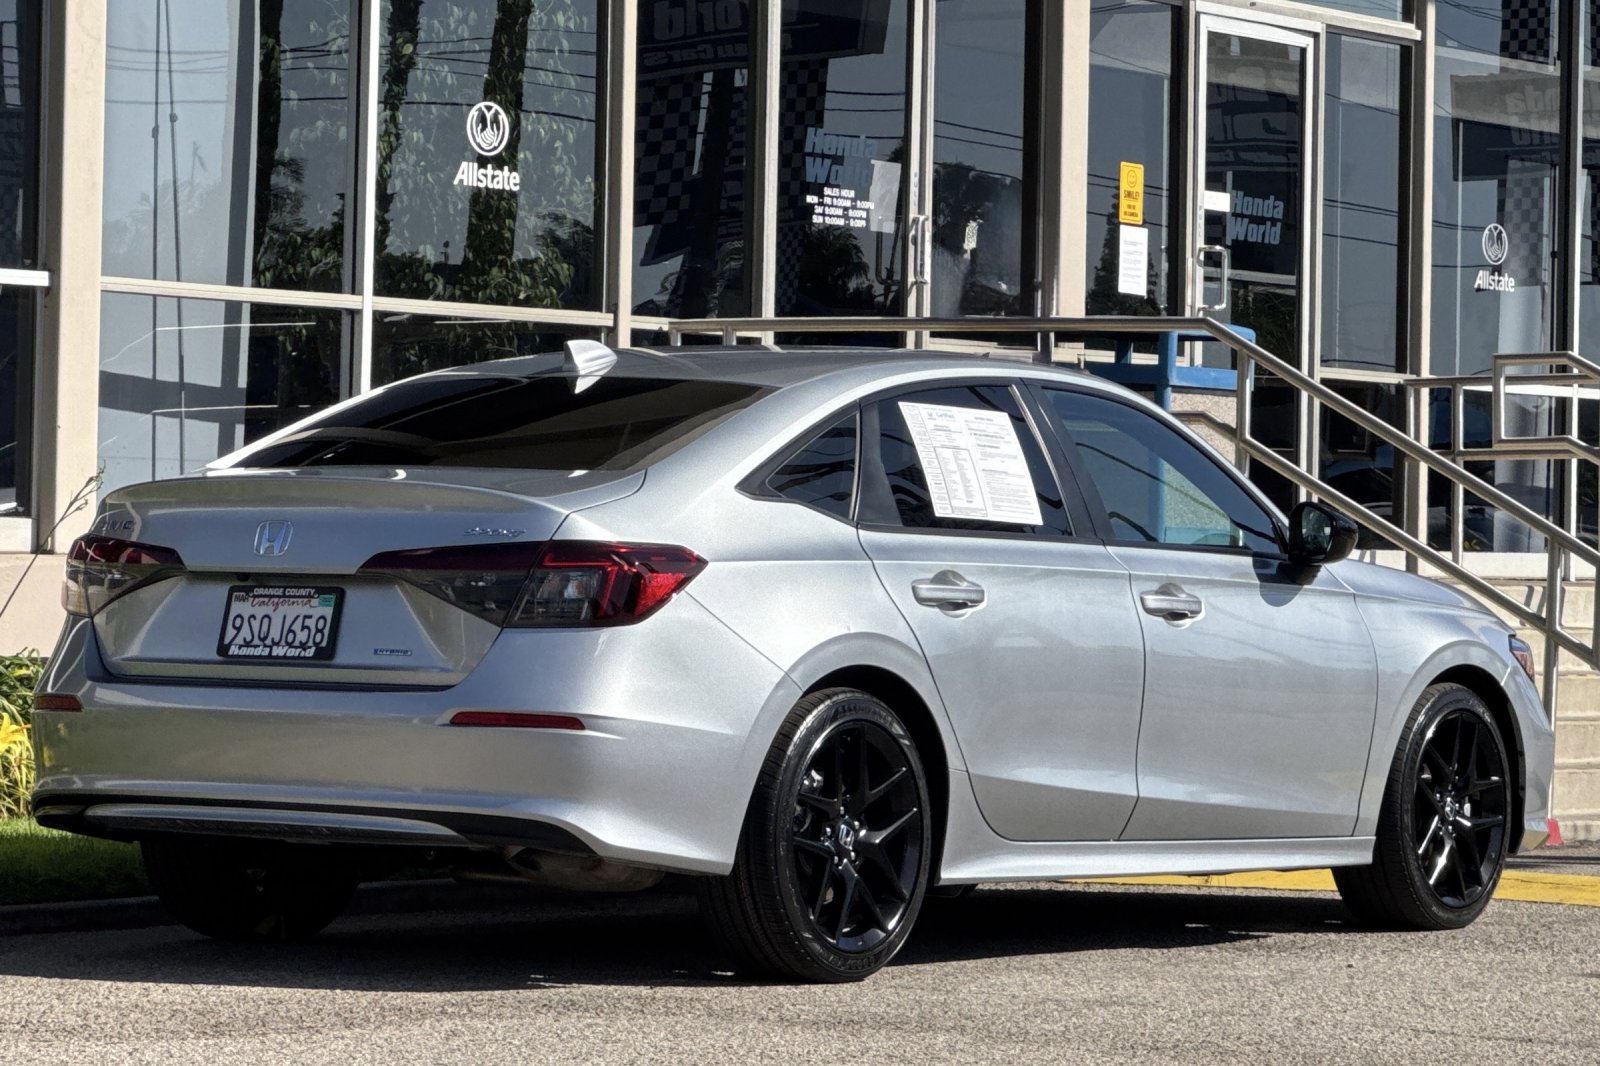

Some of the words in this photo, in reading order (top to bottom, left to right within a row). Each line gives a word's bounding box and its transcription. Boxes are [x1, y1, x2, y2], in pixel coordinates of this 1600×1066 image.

[453, 161, 520, 192] Allstate
[823, 186, 840, 197] SALES
[1230, 189, 1284, 220] Honda
[1230, 216, 1282, 245] World
[1474, 269, 1515, 293] Allstate
[250, 596, 319, 612] California
[253, 587, 284, 596] ORANGE
[285, 588, 316, 597] COUNTY
[228, 613, 328, 647] 9SQJ658
[227, 644, 271, 656] Honda
